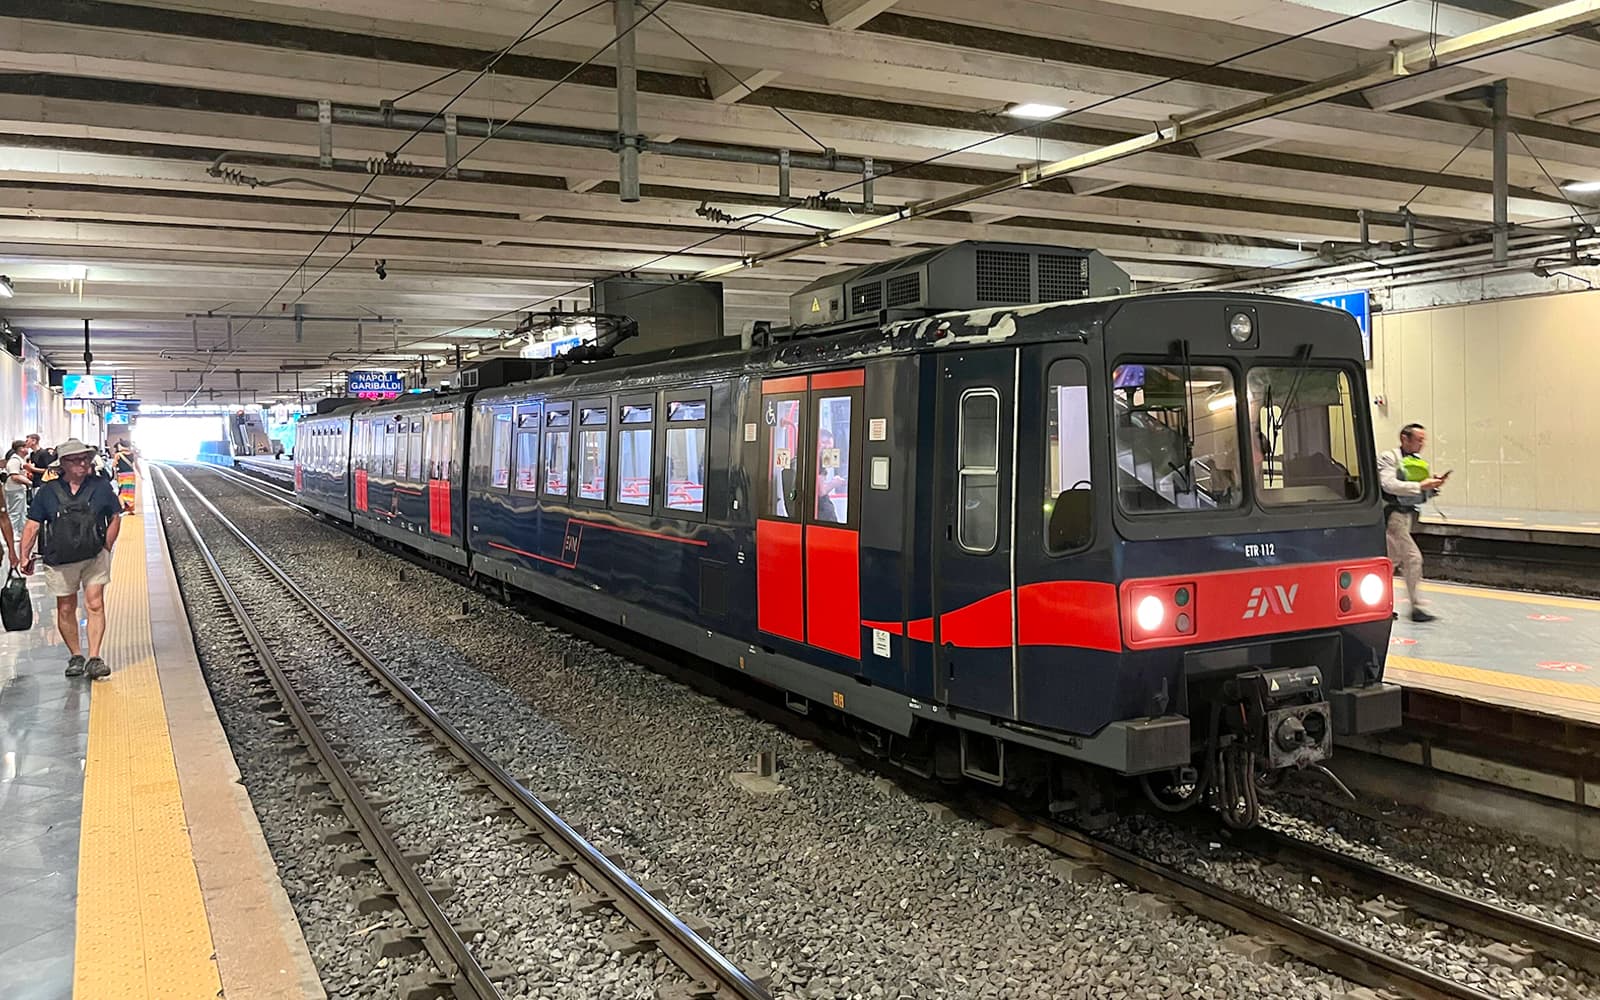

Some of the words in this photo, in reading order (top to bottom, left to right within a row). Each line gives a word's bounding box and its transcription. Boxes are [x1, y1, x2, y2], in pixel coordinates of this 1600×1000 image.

[359, 374, 393, 382] NAPOLI
[351, 382, 401, 390] GARIBALDI
[1245, 545, 1260, 557] ETR
[1261, 543, 1275, 556] 112
